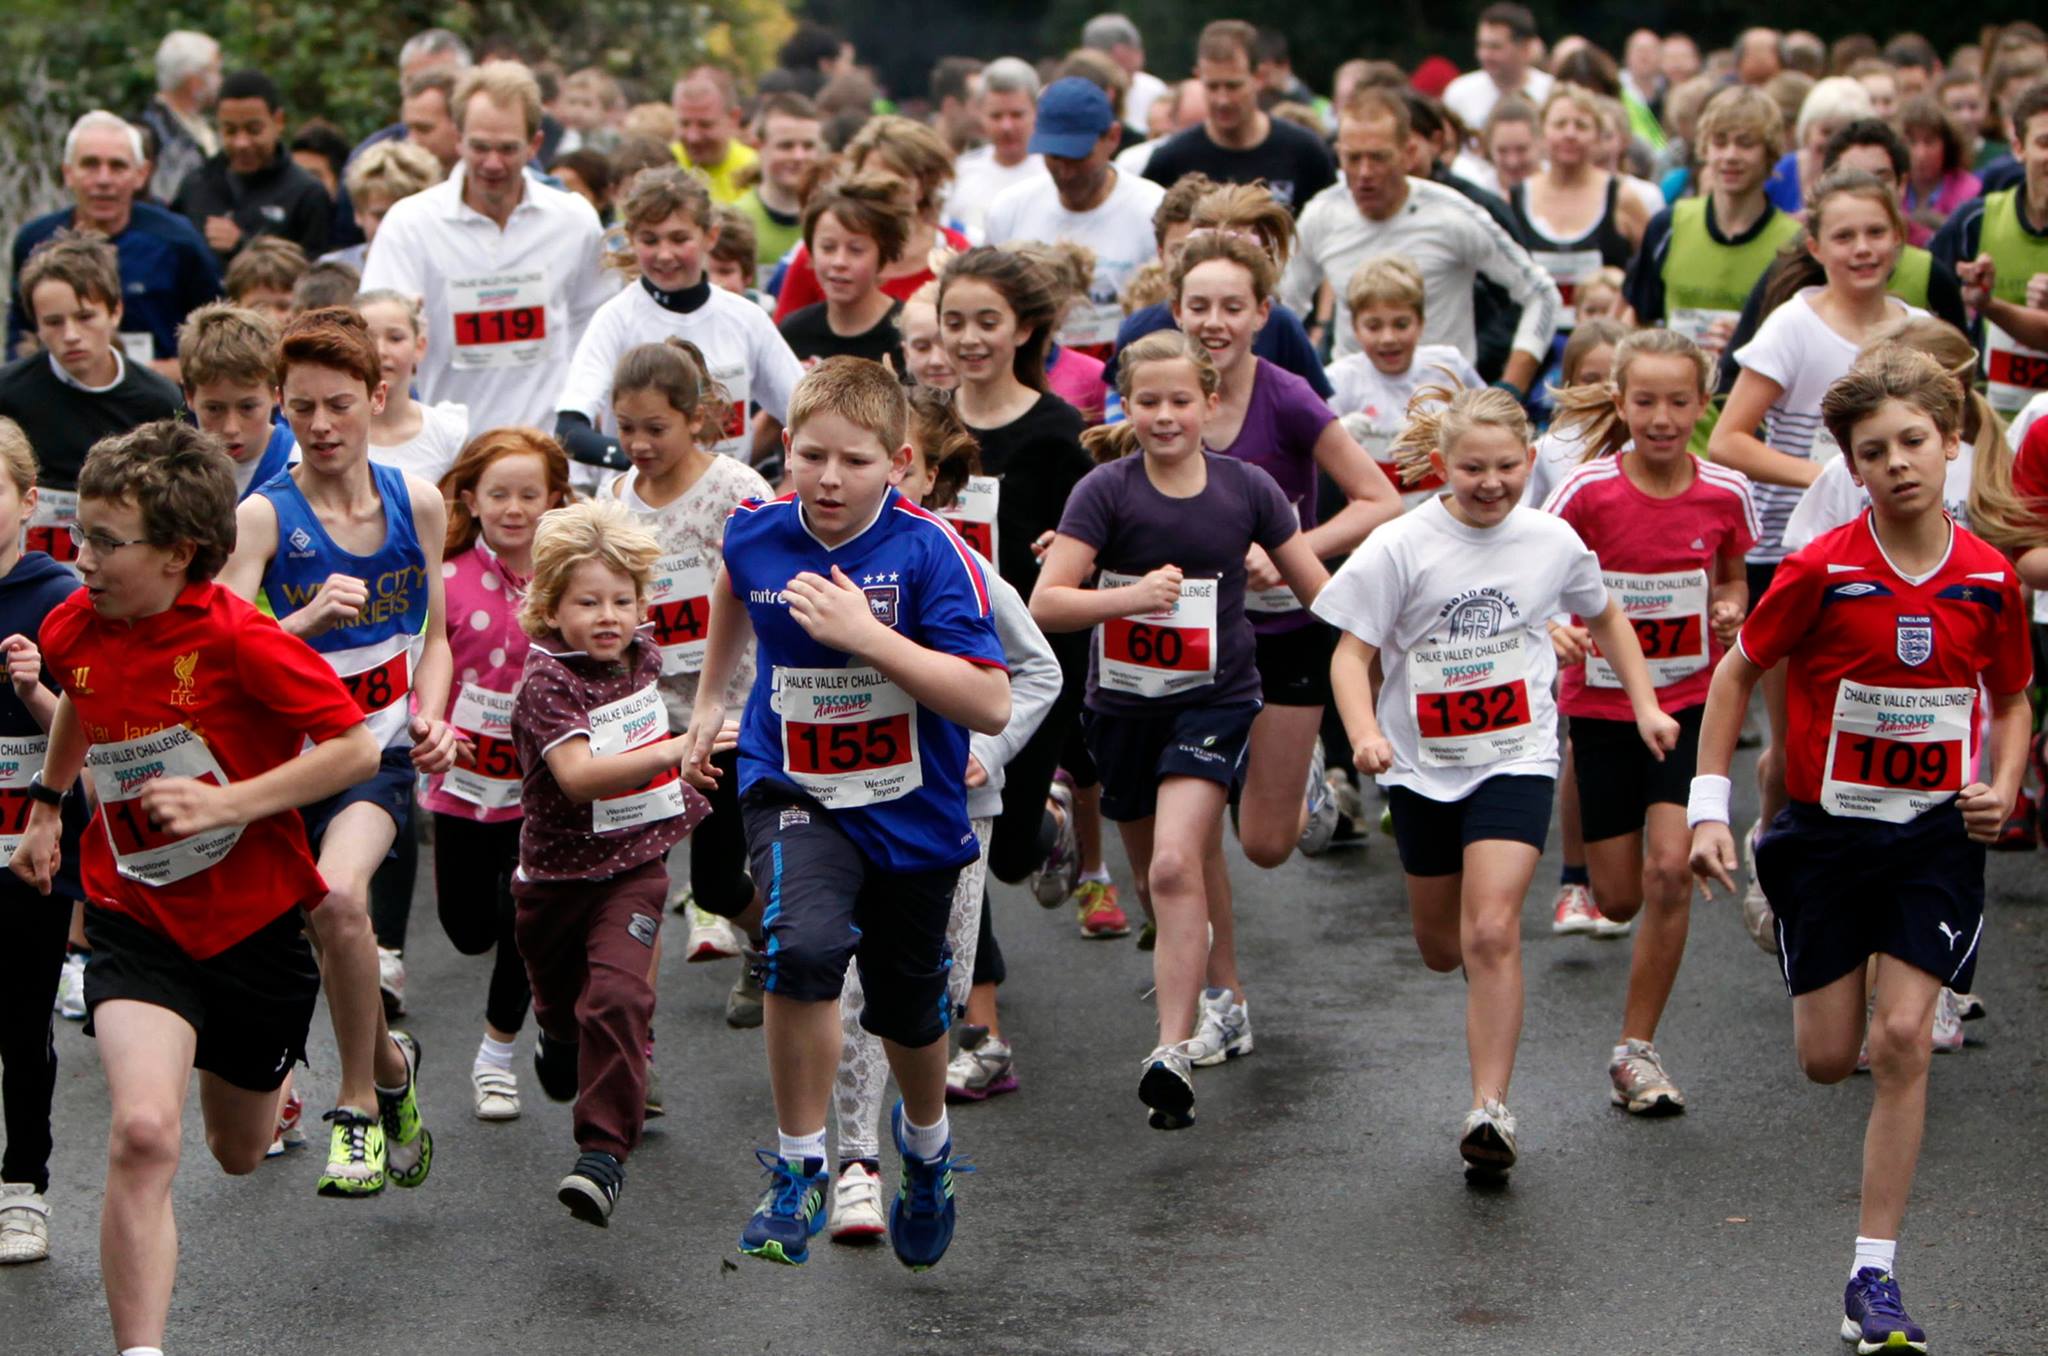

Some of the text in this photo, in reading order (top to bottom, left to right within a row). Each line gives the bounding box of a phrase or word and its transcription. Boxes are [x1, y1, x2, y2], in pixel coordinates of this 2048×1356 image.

[465, 308, 535, 344] 119
[376, 565, 427, 598] CITY
[1180, 586, 1211, 598] LLENGE
[1603, 576, 1703, 591] HALKE VALLEY CHALLENGE
[1440, 588, 1520, 619] BROAD CHALKE
[1128, 622, 1183, 667] 60
[1636, 618, 1689, 658] 37
[1416, 638, 1520, 663] CHALKE VALLEY CHALLENGE
[1442, 661, 1495, 677] DISCOVER
[815, 676, 849, 690] VALLEY
[851, 674, 890, 688] CHALLE
[812, 693, 872, 706] DISCOVER
[1844, 686, 1969, 709] CHALKE VALLEY CHALLENGE
[591, 707, 622, 728] CHALKE
[1430, 684, 1519, 734] 132
[1877, 712, 1936, 725] DISCOVER
[136, 729, 193, 759] CHALLENGE
[801, 718, 898, 770] 155
[466, 735, 523, 776] 15
[1854, 739, 1948, 788] 109
[114, 760, 165, 782] DISCOVER
[804, 785, 838, 794] stover
[864, 775, 905, 790] Westover
[872, 785, 900, 798] Toyota
[0, 793, 32, 830] 7
[604, 803, 648, 816] Westover
[610, 812, 644, 824] Nissan
[1838, 802, 1876, 813] Nissan
